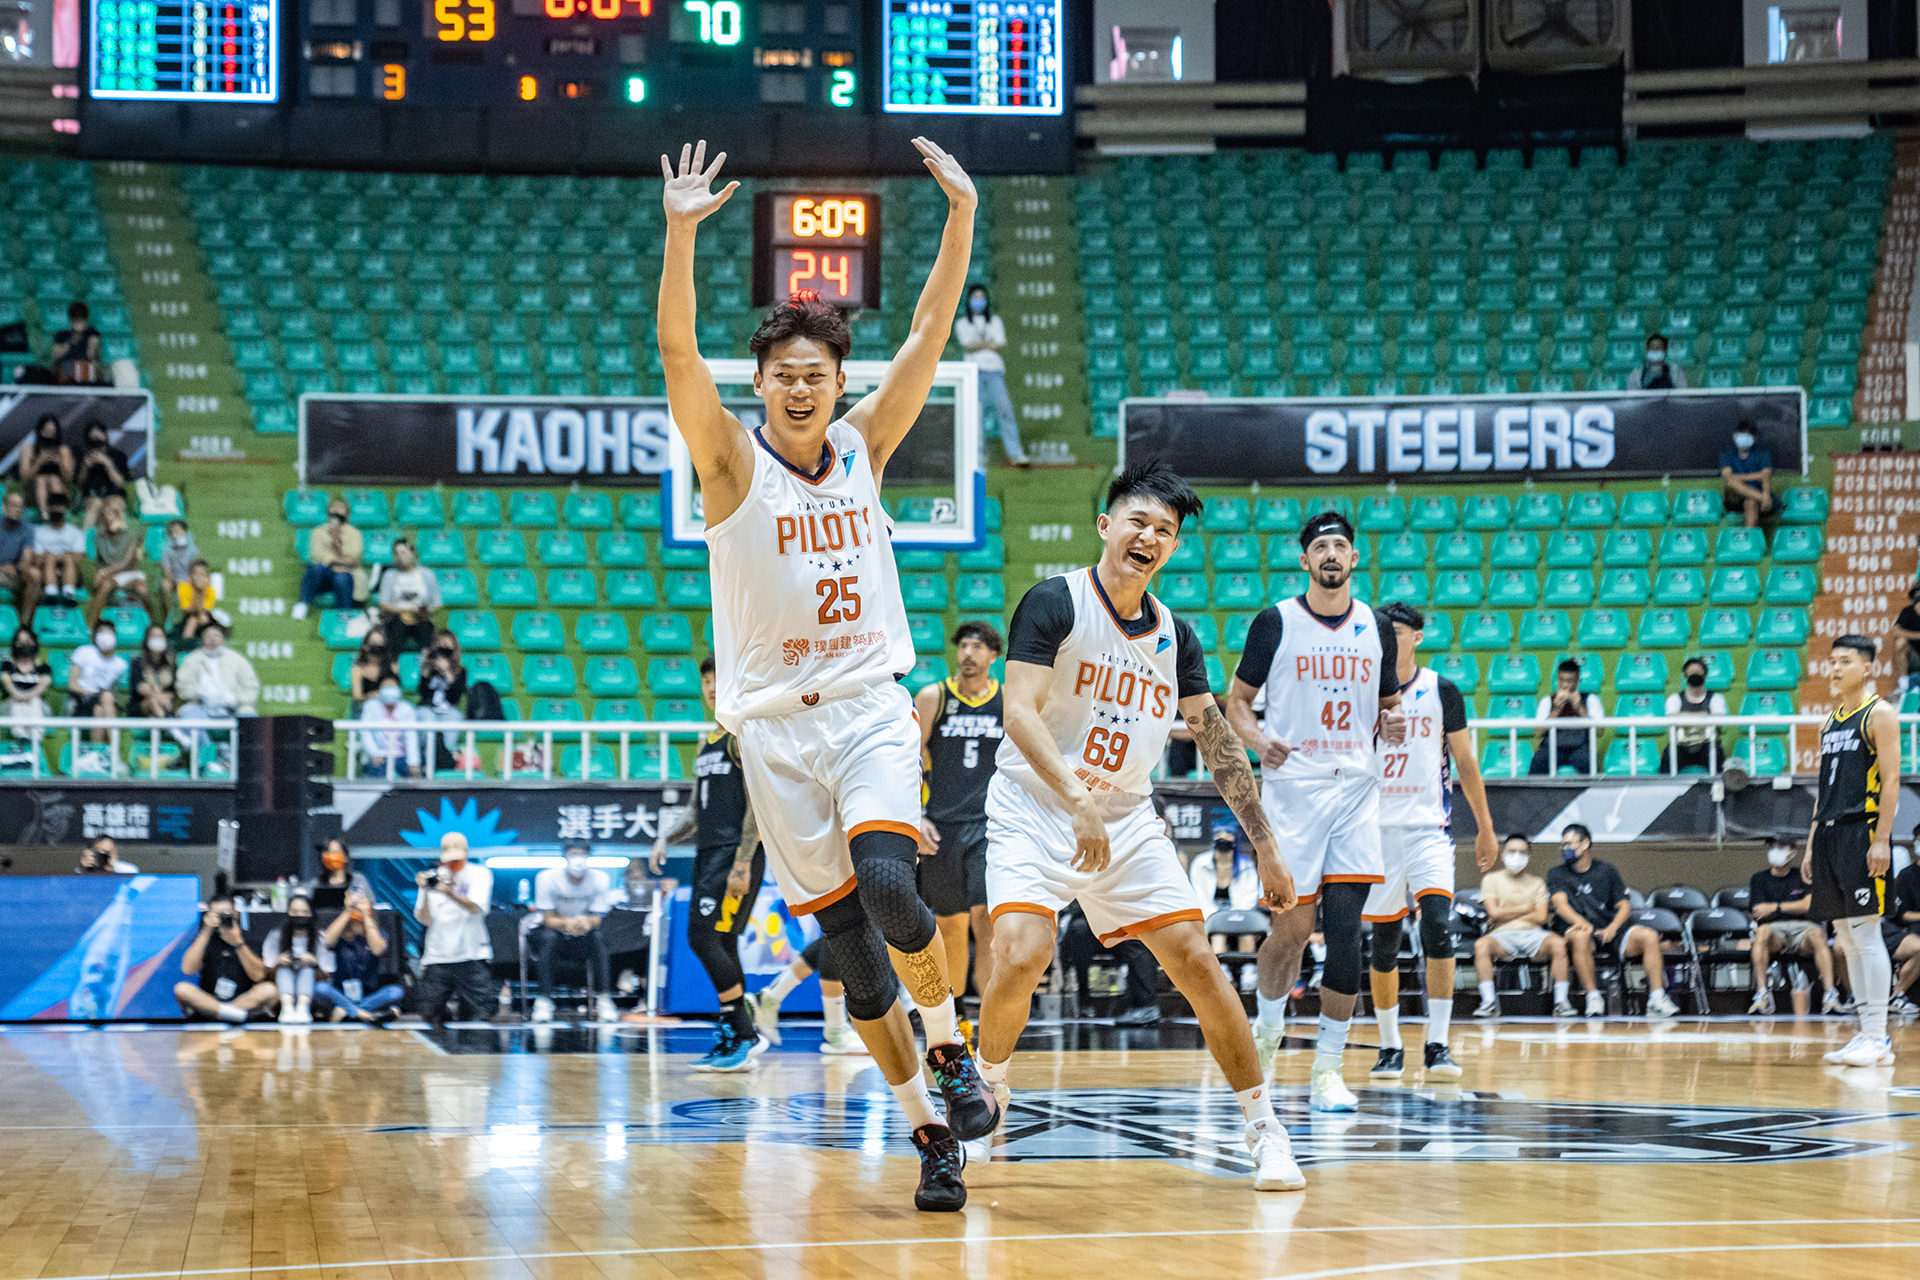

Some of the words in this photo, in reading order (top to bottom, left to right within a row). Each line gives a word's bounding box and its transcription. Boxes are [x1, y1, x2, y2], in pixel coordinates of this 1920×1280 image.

[434, 0, 496, 42] 53
[684, 0, 741, 46] 70
[383, 63, 406, 100] 3
[830, 70, 855, 107] 2
[793, 199, 865, 238] 6:09
[789, 251, 849, 299] 24
[1304, 404, 1616, 473] STEELERS
[816, 576, 861, 625] 25
[1296, 655, 1372, 684] PILOTS
[1073, 660, 1171, 720] PILOTS
[940, 726, 1004, 739] TAIPEI
[947, 714, 998, 728] NEW
[1321, 701, 1351, 730] 42
[962, 739, 979, 769] 5
[1082, 726, 1130, 772] 69
[1384, 753, 1409, 778] 27
